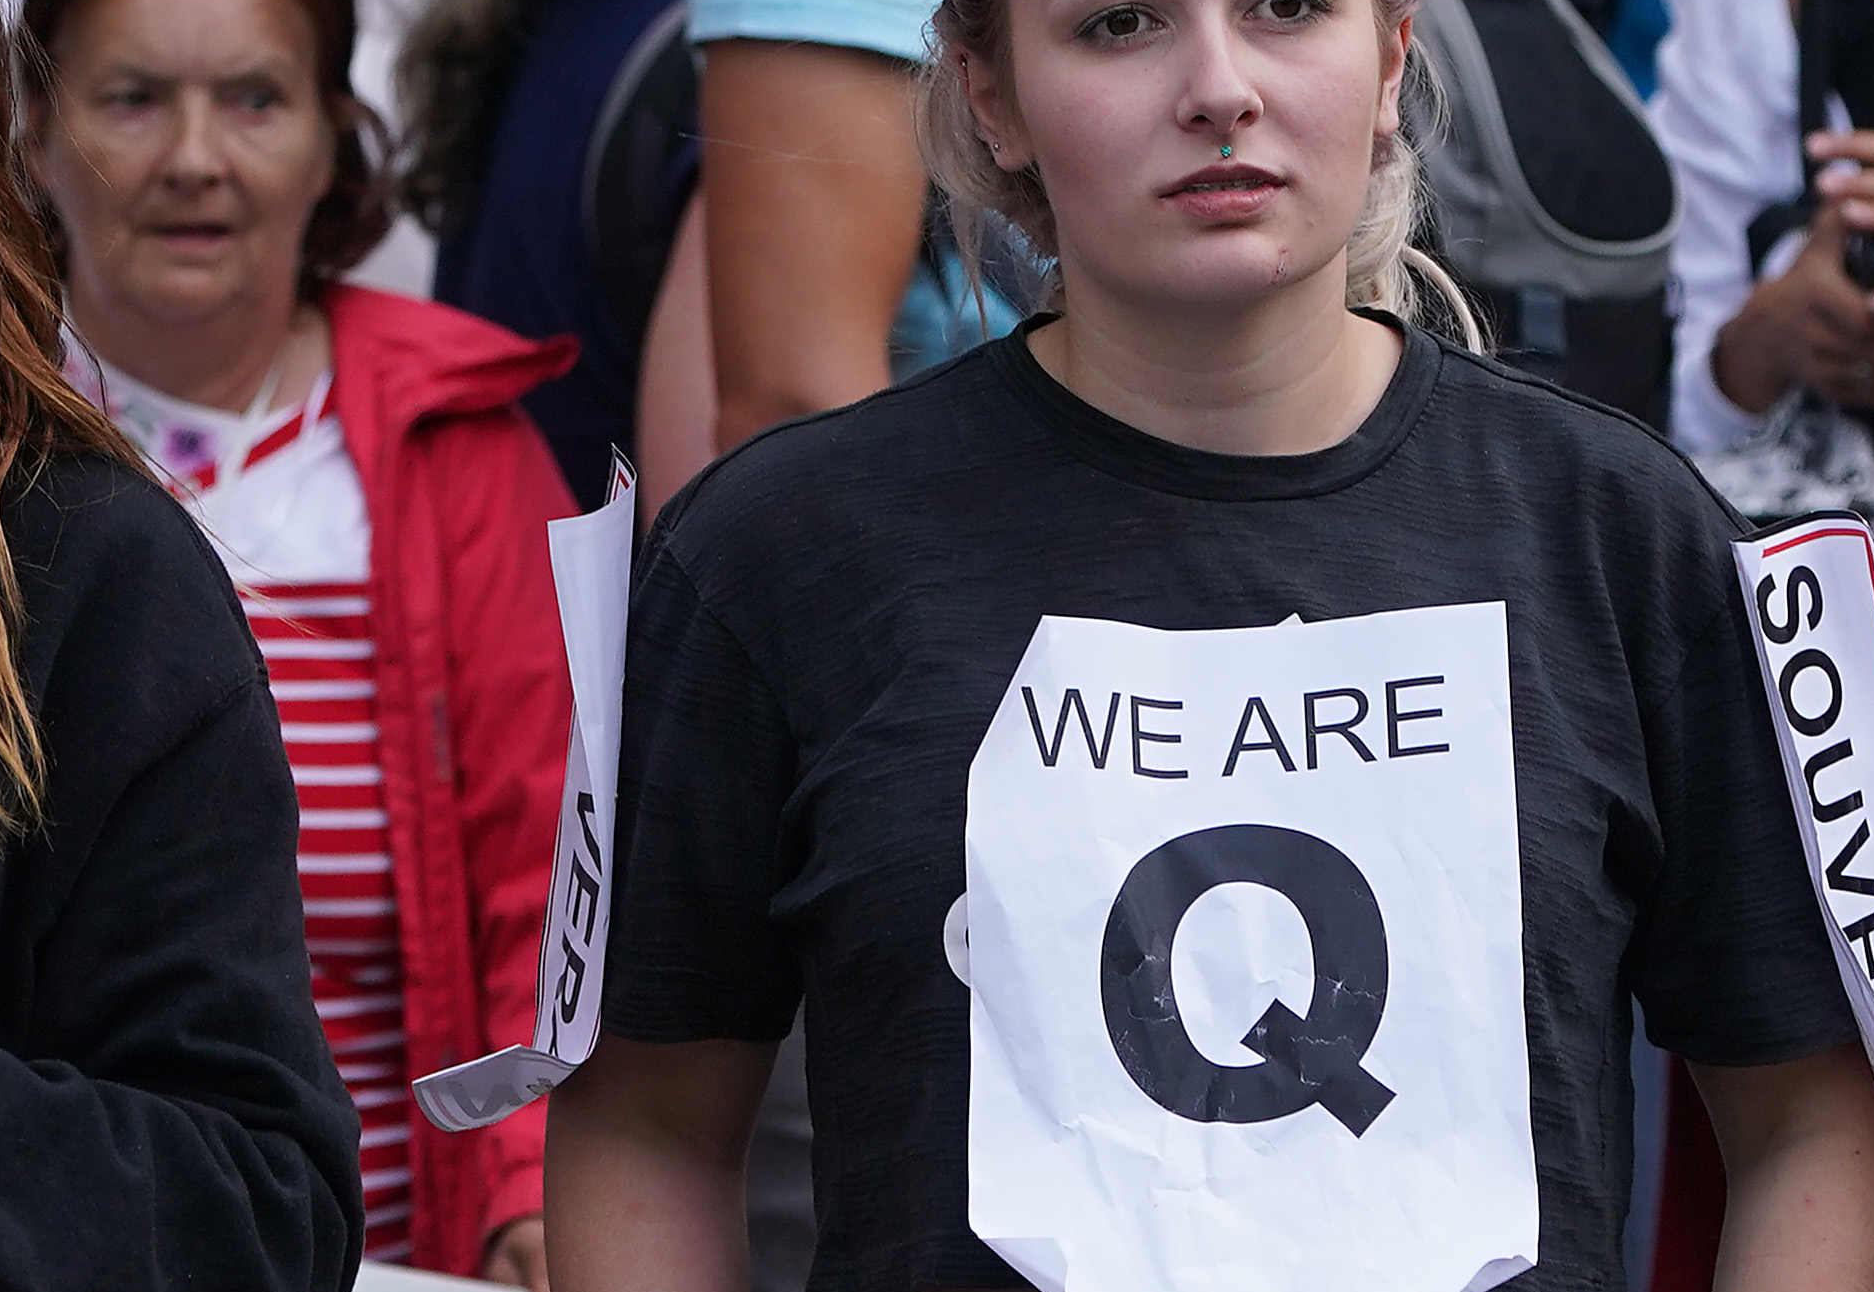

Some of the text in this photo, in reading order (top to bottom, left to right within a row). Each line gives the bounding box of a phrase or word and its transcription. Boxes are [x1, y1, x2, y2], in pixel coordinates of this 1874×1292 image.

[1020, 674, 1451, 780] WE ARE
[1099, 822, 1397, 1139] Q
